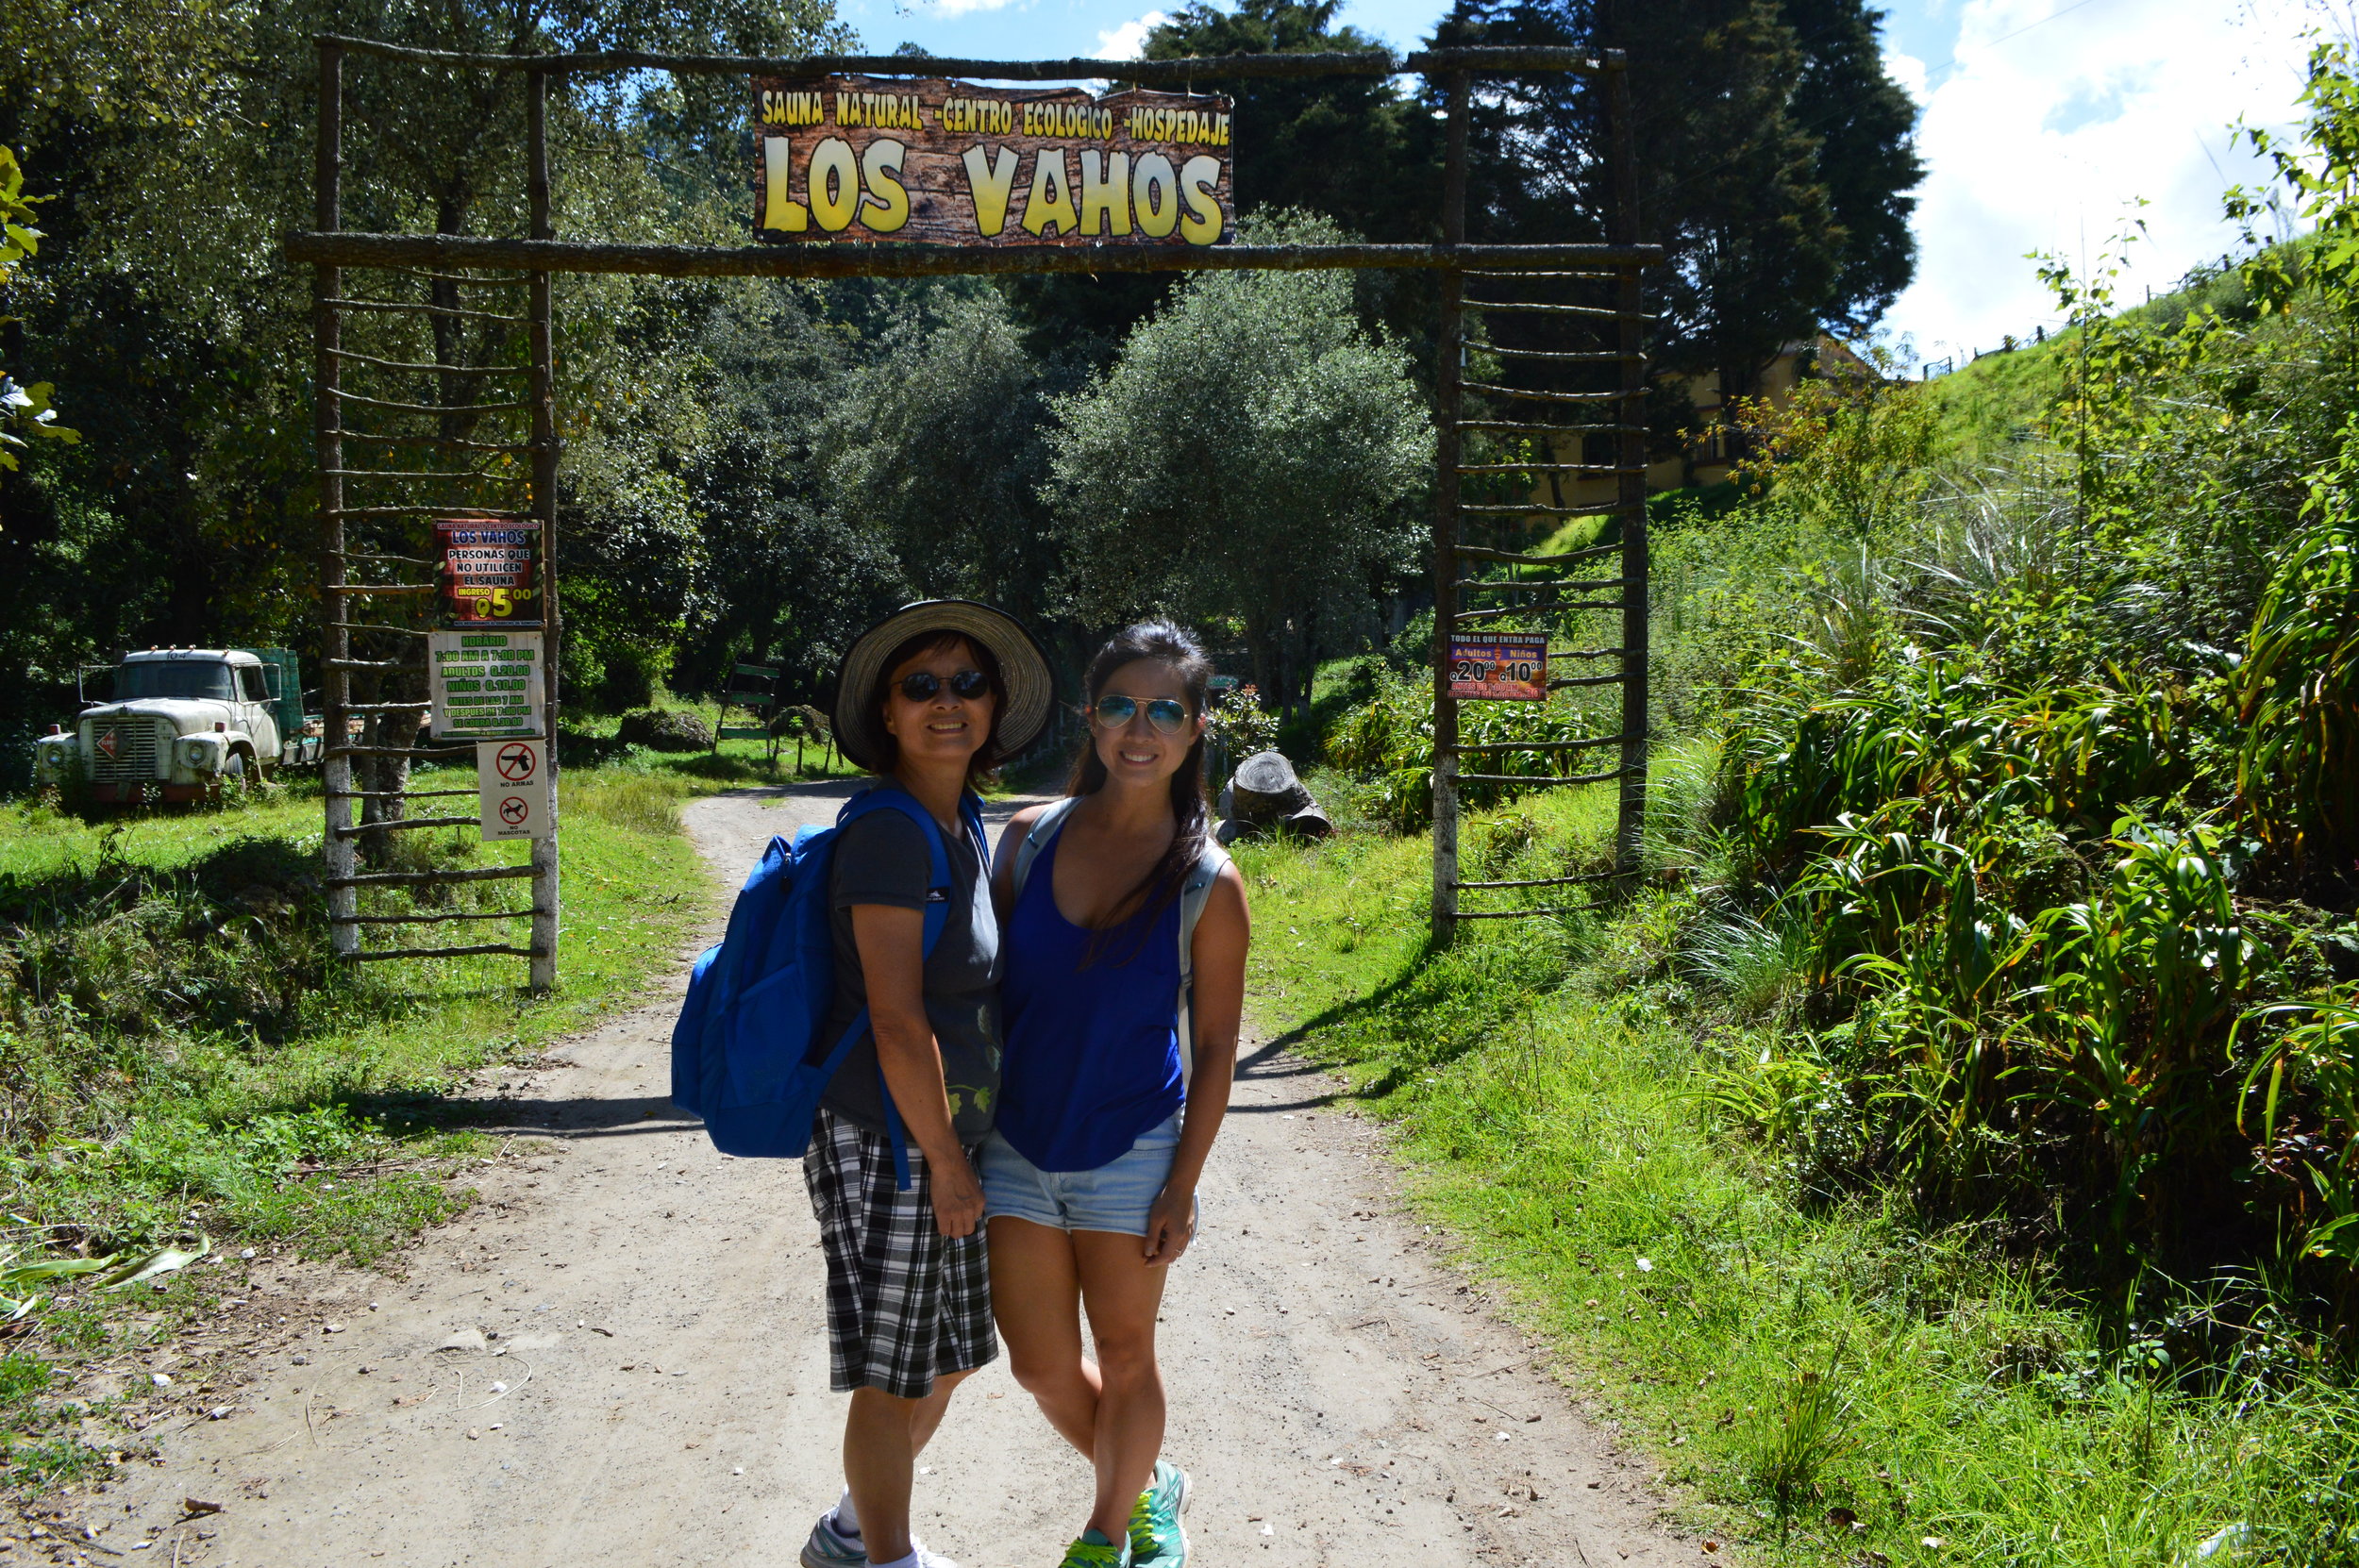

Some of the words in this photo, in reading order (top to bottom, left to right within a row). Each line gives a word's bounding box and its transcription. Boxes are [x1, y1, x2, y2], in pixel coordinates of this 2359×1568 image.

[761, 91, 824, 125] SAUNA
[836, 92, 923, 131] NATURAL
[1022, 102, 1112, 140] ECOLOGICO
[762, 135, 911, 234] LOS
[961, 143, 1224, 246] VAHOS
[452, 531, 477, 544] LOS
[480, 531, 526, 544] VAHOS
[448, 550, 505, 560] PERSONAS
[507, 549, 530, 561] QUE
[457, 563, 472, 572] NO
[475, 563, 522, 572] UTILICEN
[464, 576, 475, 585] EL
[478, 576, 515, 585] SAUNA
[458, 588, 490, 596] INGRESO
[461, 636, 507, 646] HORARIO
[435, 651, 459, 662] 7:00
[461, 651, 479, 661] AM
[481, 651, 489, 661] A
[491, 650, 514, 660] 7:00
[517, 650, 535, 660] PM
[1455, 648, 1492, 657] Adultos
[1510, 649, 1537, 658] Niños
[441, 666, 485, 677] ADULTOS
[447, 679, 480, 692] NIÑOS
[447, 697, 472, 706] ANTES
[474, 697, 484, 705] DE
[486, 696, 501, 705] LAS
[502, 696, 508, 705] 7
[510, 696, 524, 704] AM
[443, 709, 450, 717] Y
[450, 708, 484, 717] DESPUES
[486, 707, 496, 716] DE
[498, 707, 516, 716] 7:00
[518, 706, 531, 715] PM
[453, 719, 463, 727] SE
[465, 718, 490, 727] COBRA
